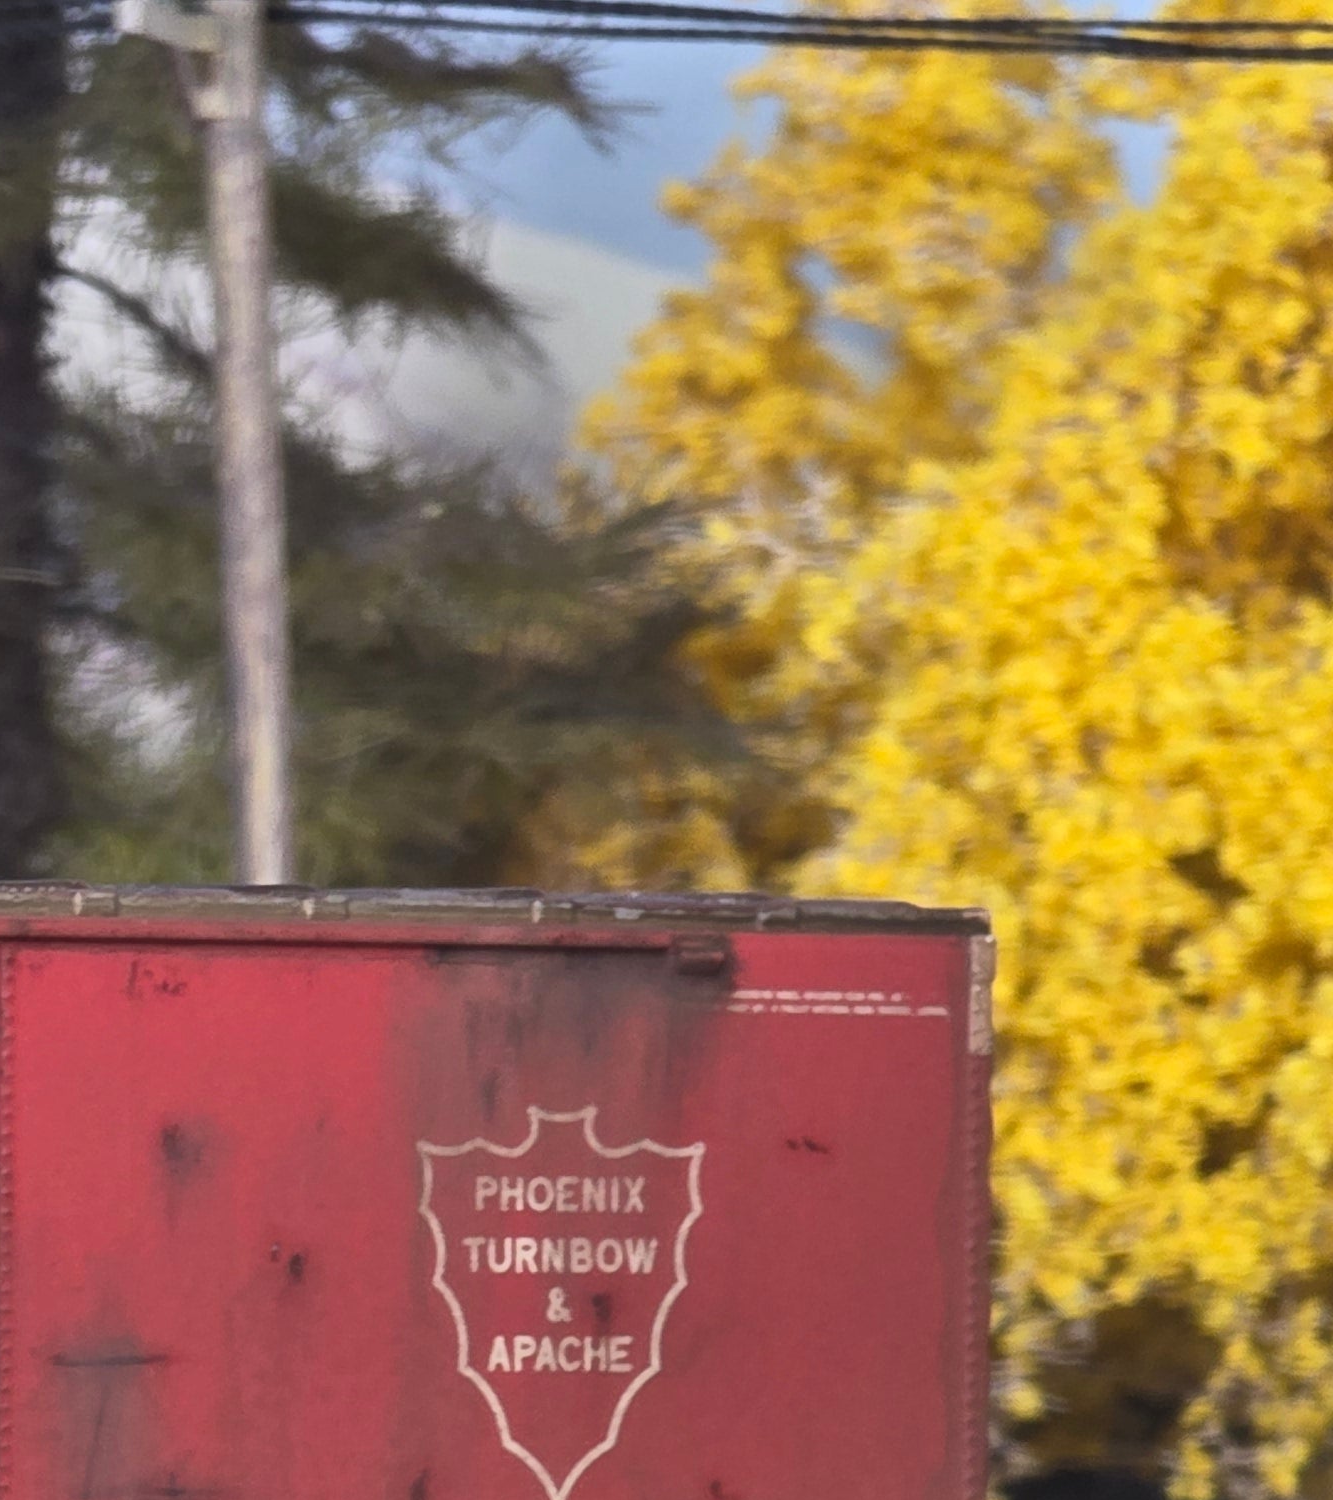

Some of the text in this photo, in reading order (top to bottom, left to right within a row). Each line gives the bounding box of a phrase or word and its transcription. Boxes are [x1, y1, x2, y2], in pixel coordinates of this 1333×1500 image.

[474, 1175, 646, 1213] PHOENIX
[462, 1236, 658, 1275] TURNBOW
[546, 1286, 572, 1322] &
[487, 1334, 634, 1373] APACHE
